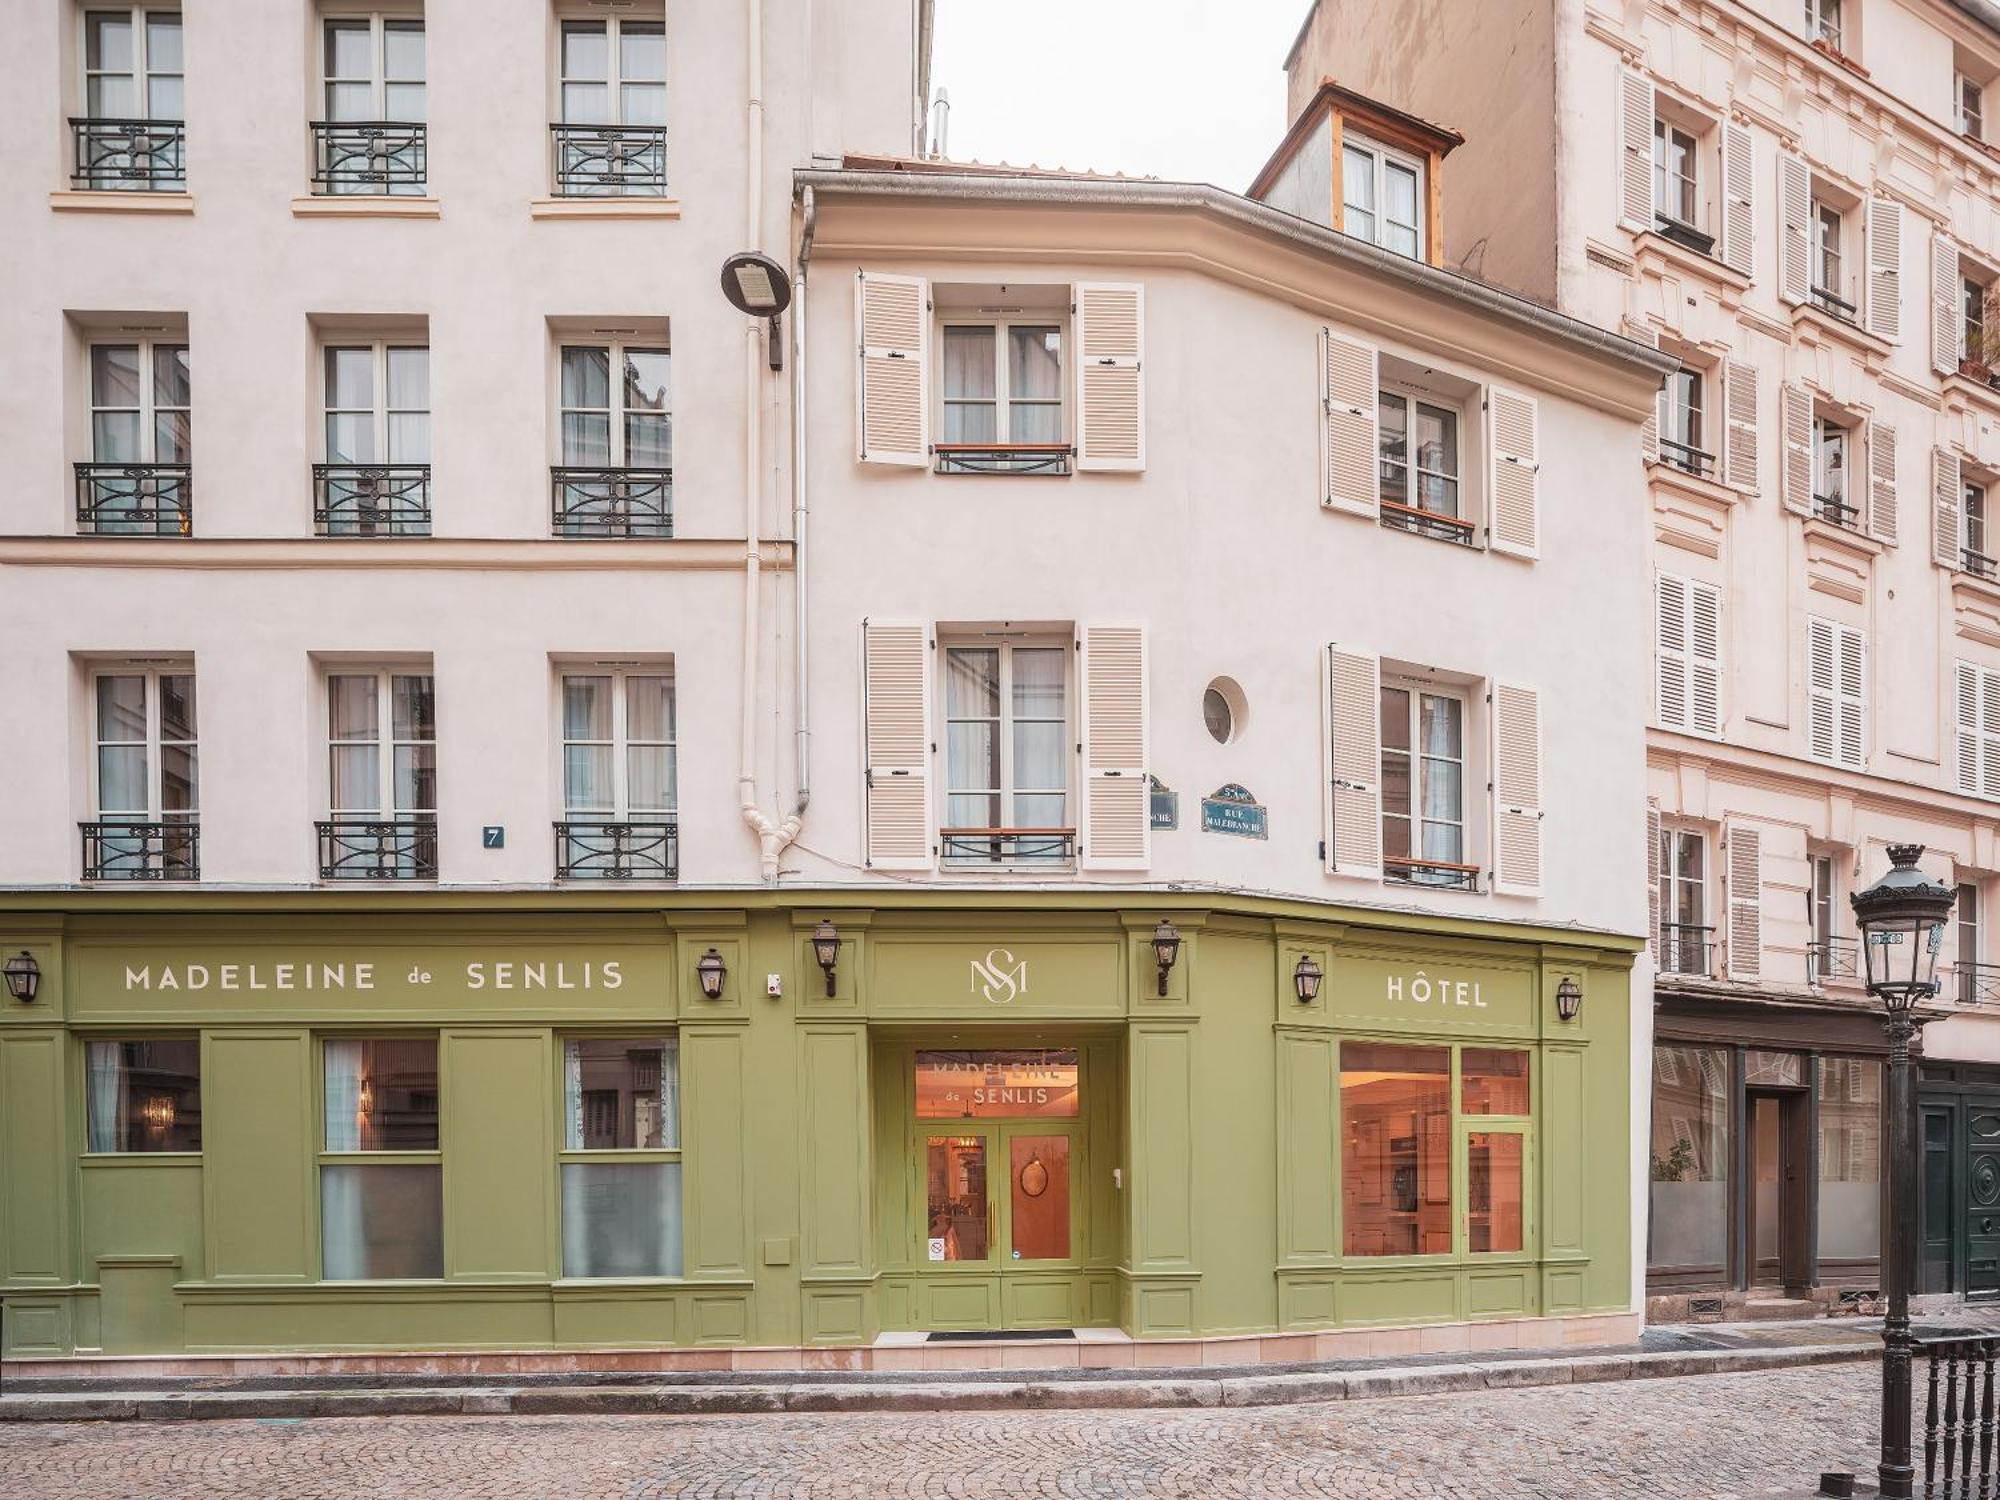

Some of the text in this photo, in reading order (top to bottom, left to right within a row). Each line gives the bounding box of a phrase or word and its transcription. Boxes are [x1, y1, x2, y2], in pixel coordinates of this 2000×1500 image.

[1224, 808, 1244, 819] RUE
[488, 829, 499, 846] 7
[126, 961, 623, 990] MADELEINE de SENLIS
[1386, 970, 1488, 1008] HÔTEL
[933, 1062, 1060, 1080] MADELEINE
[945, 1087, 1048, 1104] de SENLIS
